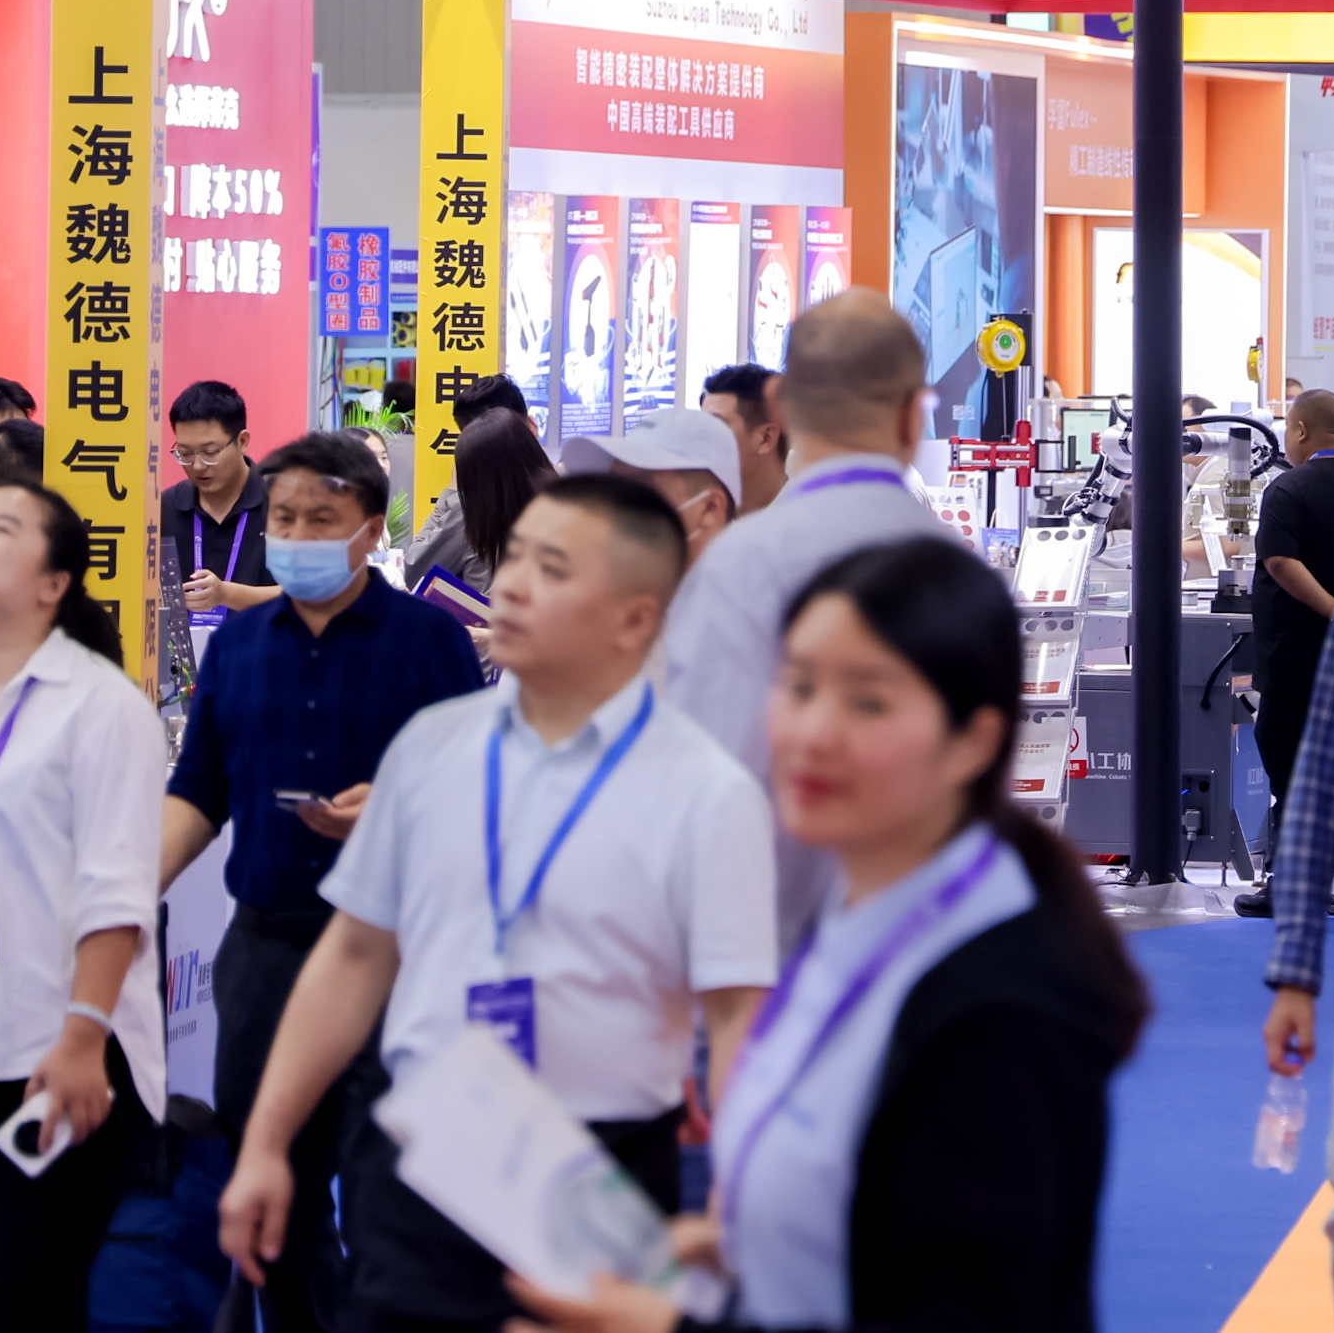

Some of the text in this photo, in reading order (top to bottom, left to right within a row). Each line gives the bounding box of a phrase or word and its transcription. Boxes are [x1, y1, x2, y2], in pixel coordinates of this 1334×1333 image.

[714, 0, 763, 35] Technology
[792, 10, 808, 35] Ltd
[575, 46, 765, 100] 智能精密装配整体解决方案提供商
[607, 98, 735, 141] 中国高端装配工具供应商
[357, 232, 380, 331] 橡胶制品
[61, 46, 134, 643] 上海魏德电气有
